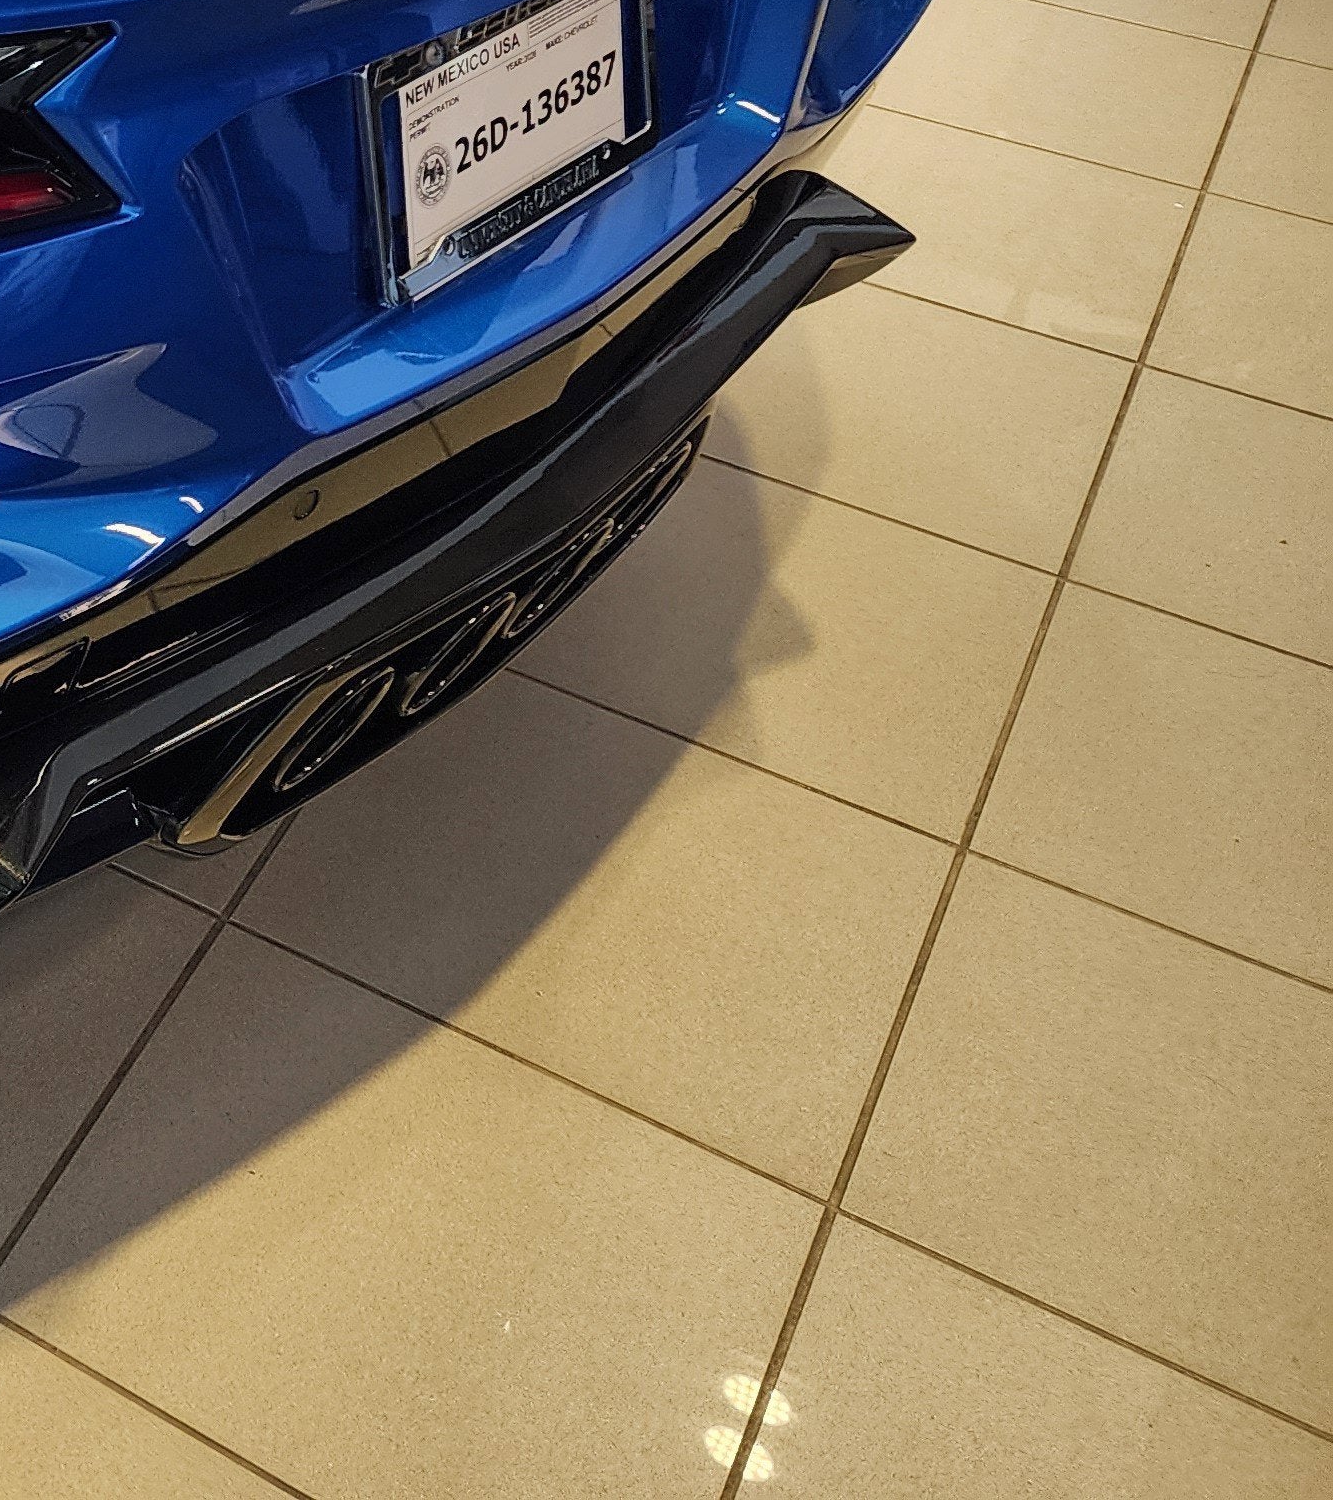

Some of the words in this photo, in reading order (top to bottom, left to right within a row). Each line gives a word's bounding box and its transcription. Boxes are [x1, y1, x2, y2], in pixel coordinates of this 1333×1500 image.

[405, 77, 435, 108] NEW
[437, 48, 490, 89] MEXICO
[493, 32, 521, 59] USA
[408, 94, 460, 131] DEMONSTRATION
[455, 49, 617, 175] 26D-136387
